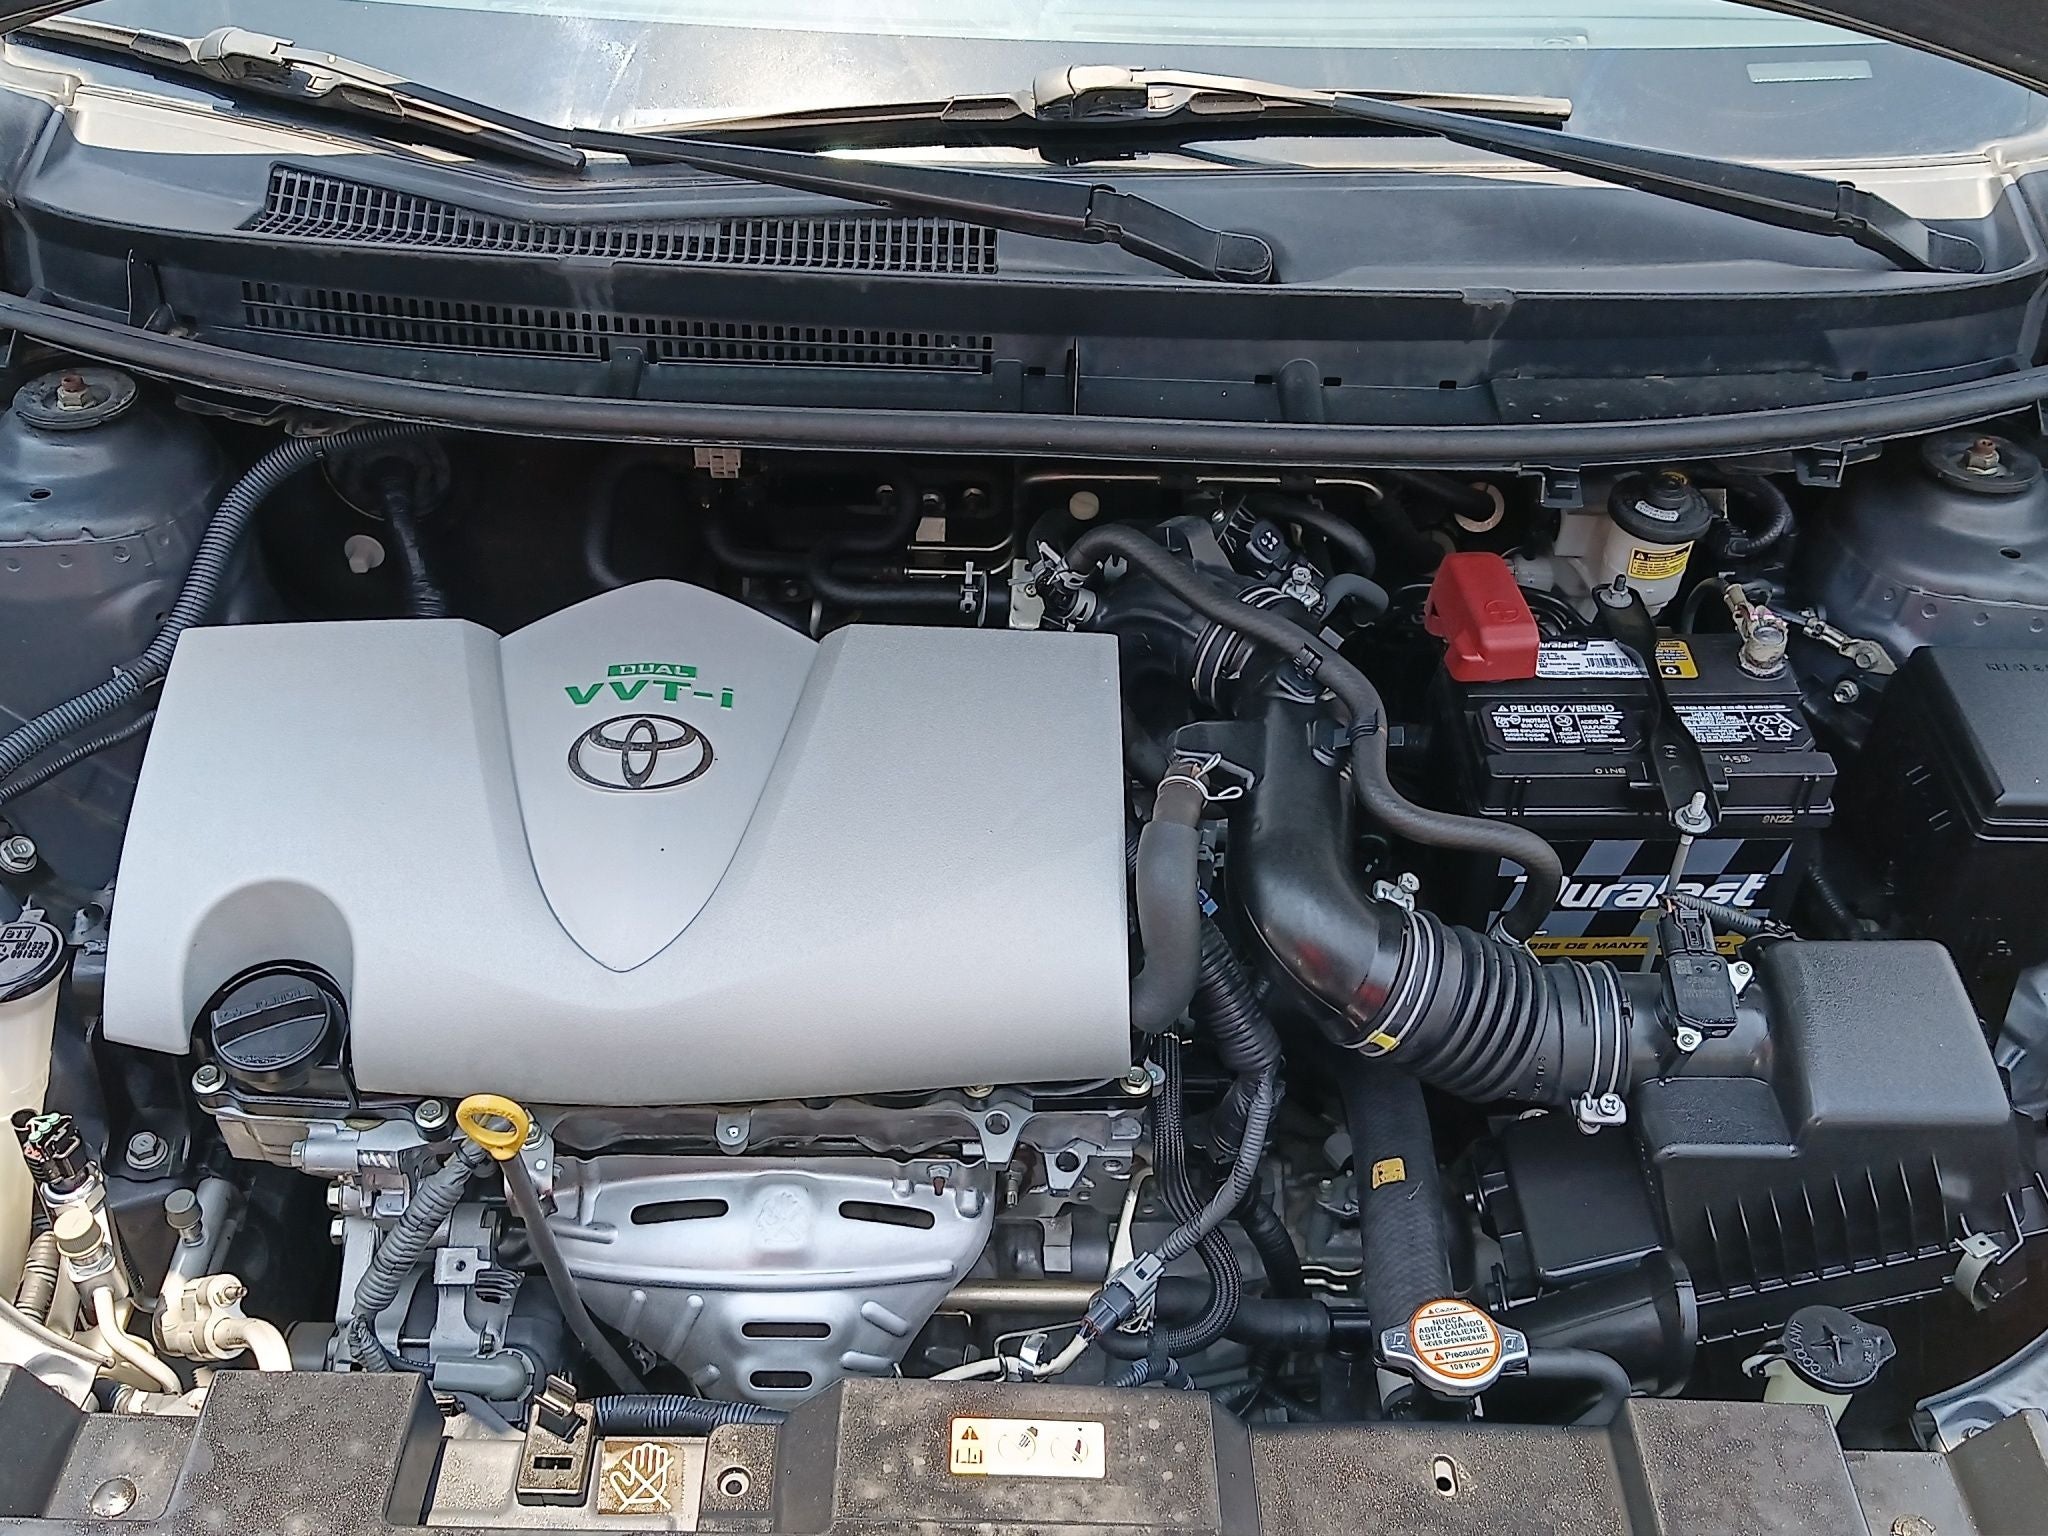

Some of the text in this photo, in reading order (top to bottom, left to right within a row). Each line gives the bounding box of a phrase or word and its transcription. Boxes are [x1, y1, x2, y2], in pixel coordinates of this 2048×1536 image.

[1538, 641, 1579, 649] uralast
[619, 664, 690, 676] DUAL
[564, 679, 734, 710] VVT-i
[1510, 704, 1615, 713] PELIGRO/VENENO
[1564, 942, 1589, 950] DE
[1432, 1316, 1464, 1326] NUNCA
[1444, 1319, 1483, 1331] CUANDO
[1418, 1325, 1488, 1341] ESTE CALIENTE
[1444, 1346, 1490, 1359] Precaución
[1789, 1320, 1821, 1374] COOLANT
